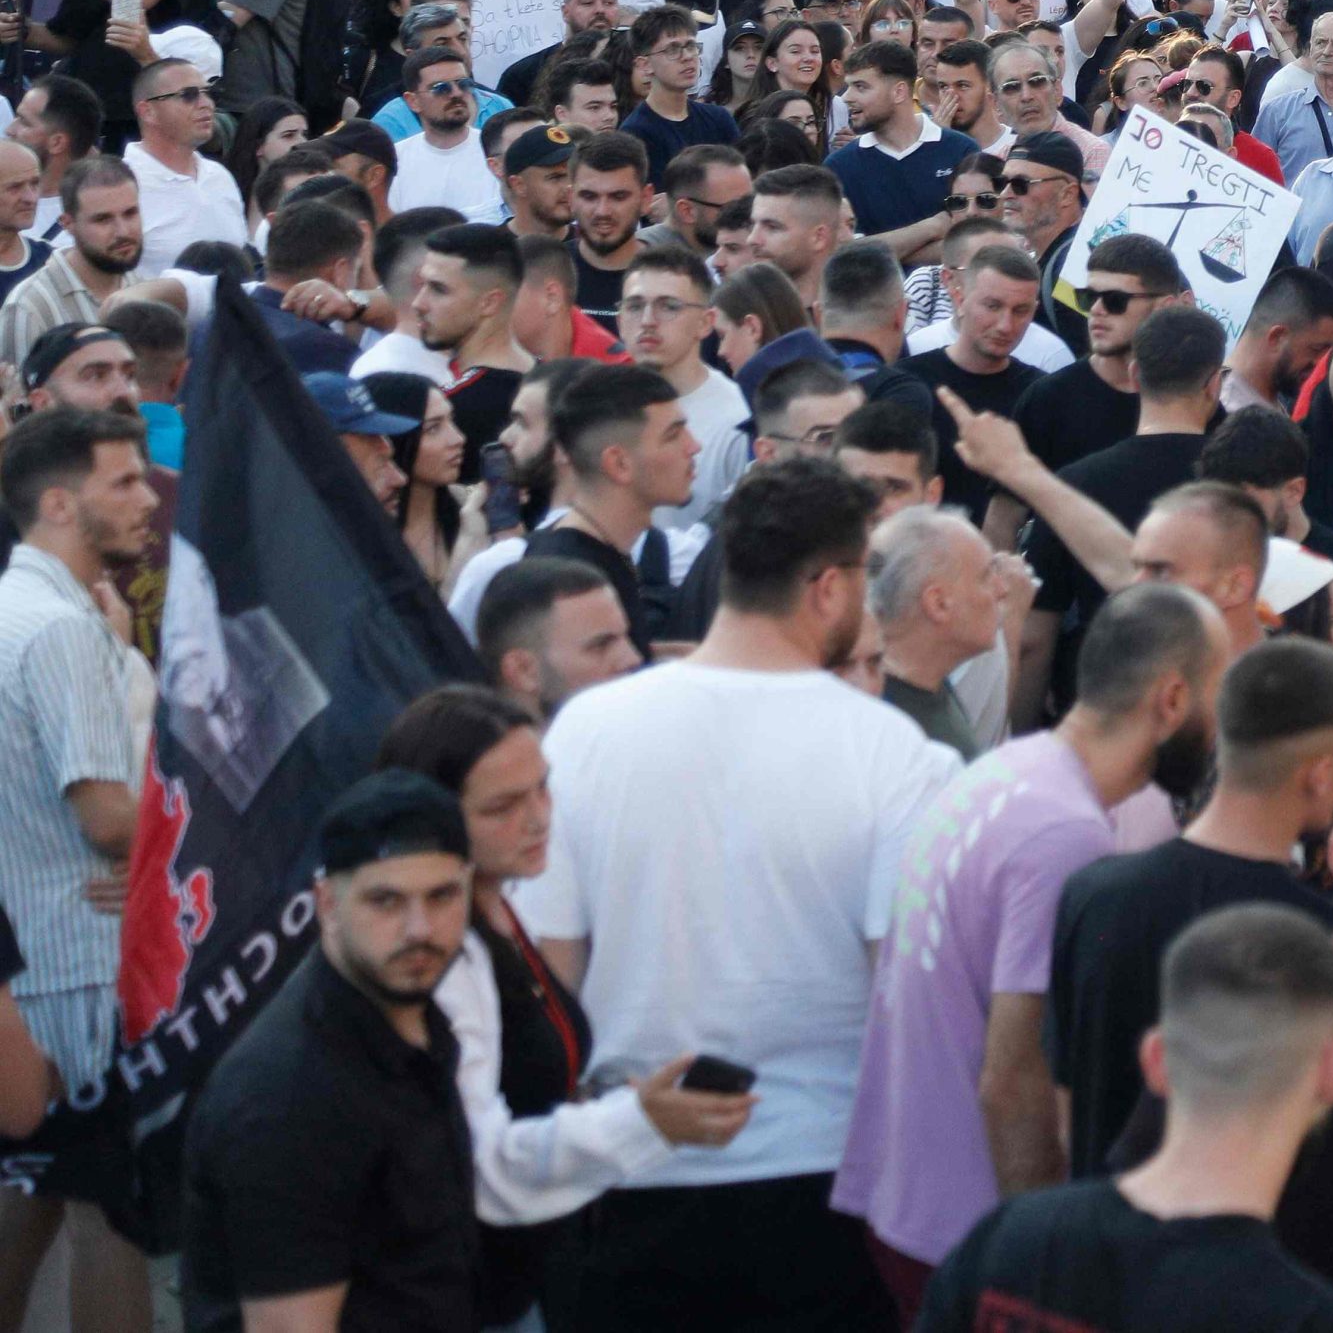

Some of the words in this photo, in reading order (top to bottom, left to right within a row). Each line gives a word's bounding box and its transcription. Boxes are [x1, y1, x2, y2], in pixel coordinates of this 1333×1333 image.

[1116, 156, 1155, 193] ME
[1129, 114, 1163, 150] JO
[1178, 139, 1275, 217] TREGTI
